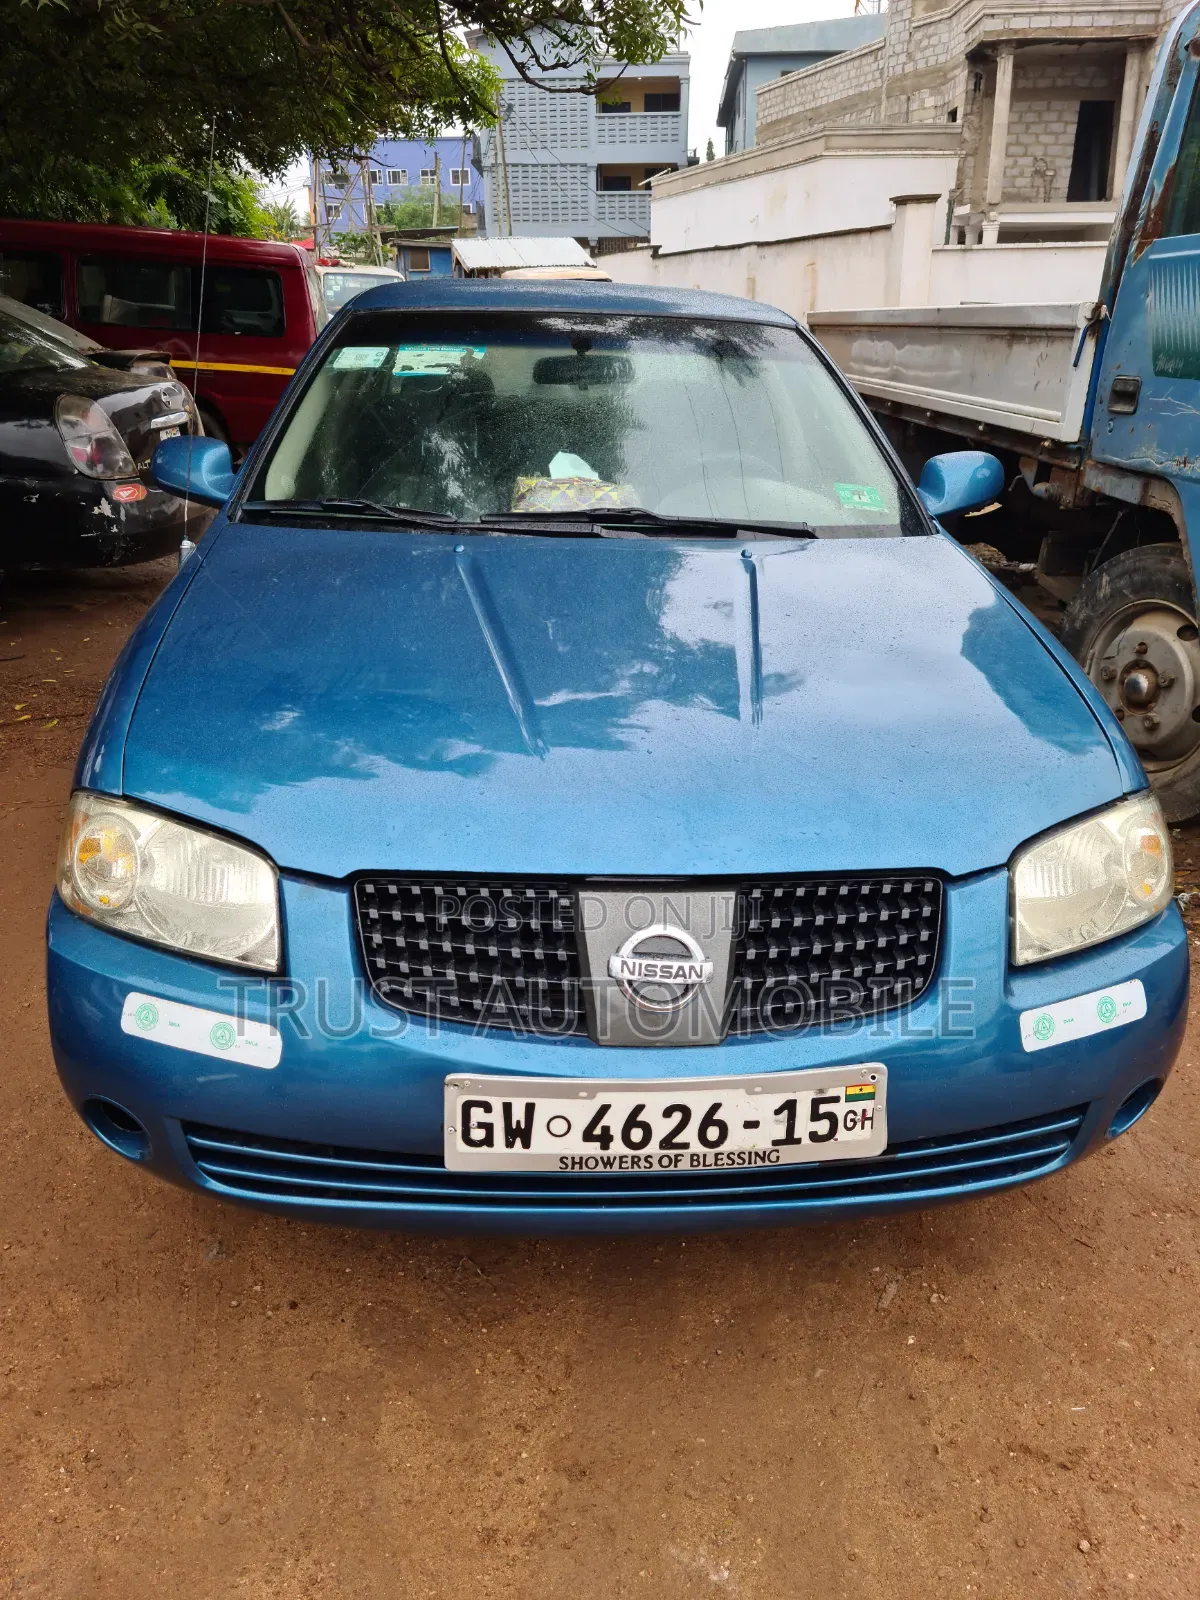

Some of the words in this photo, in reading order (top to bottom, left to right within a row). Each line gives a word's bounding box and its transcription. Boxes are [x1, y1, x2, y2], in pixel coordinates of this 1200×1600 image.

[620, 960, 704, 980] NISSAN
[461, 1099, 536, 1150] GW
[843, 1107, 875, 1132] GH
[558, 1154, 654, 1171] SHOWERS
[658, 1153, 685, 1169] OF
[689, 1149, 780, 1168] BLESSING
